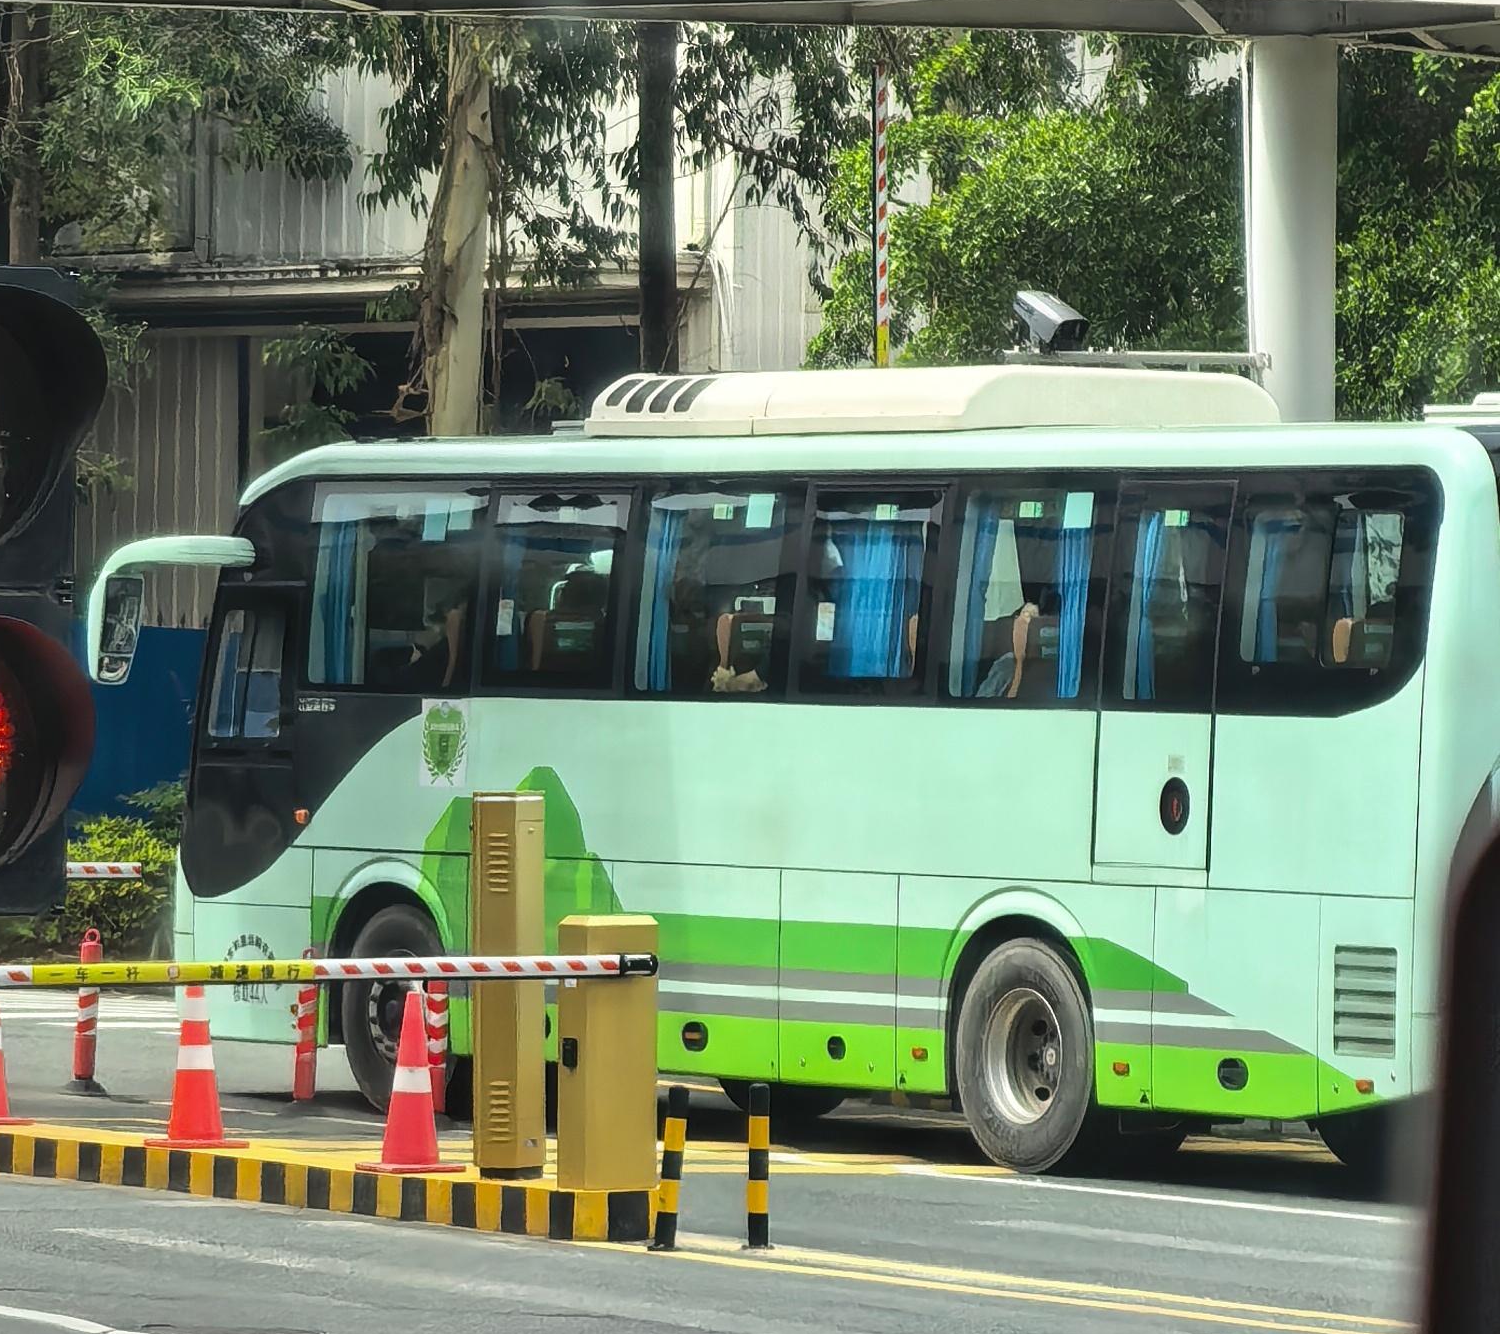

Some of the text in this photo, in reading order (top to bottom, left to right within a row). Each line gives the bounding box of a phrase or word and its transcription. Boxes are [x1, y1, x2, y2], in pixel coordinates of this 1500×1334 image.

[49, 965, 140, 982] 一车一杆
[209, 963, 300, 980] 减速慢行
